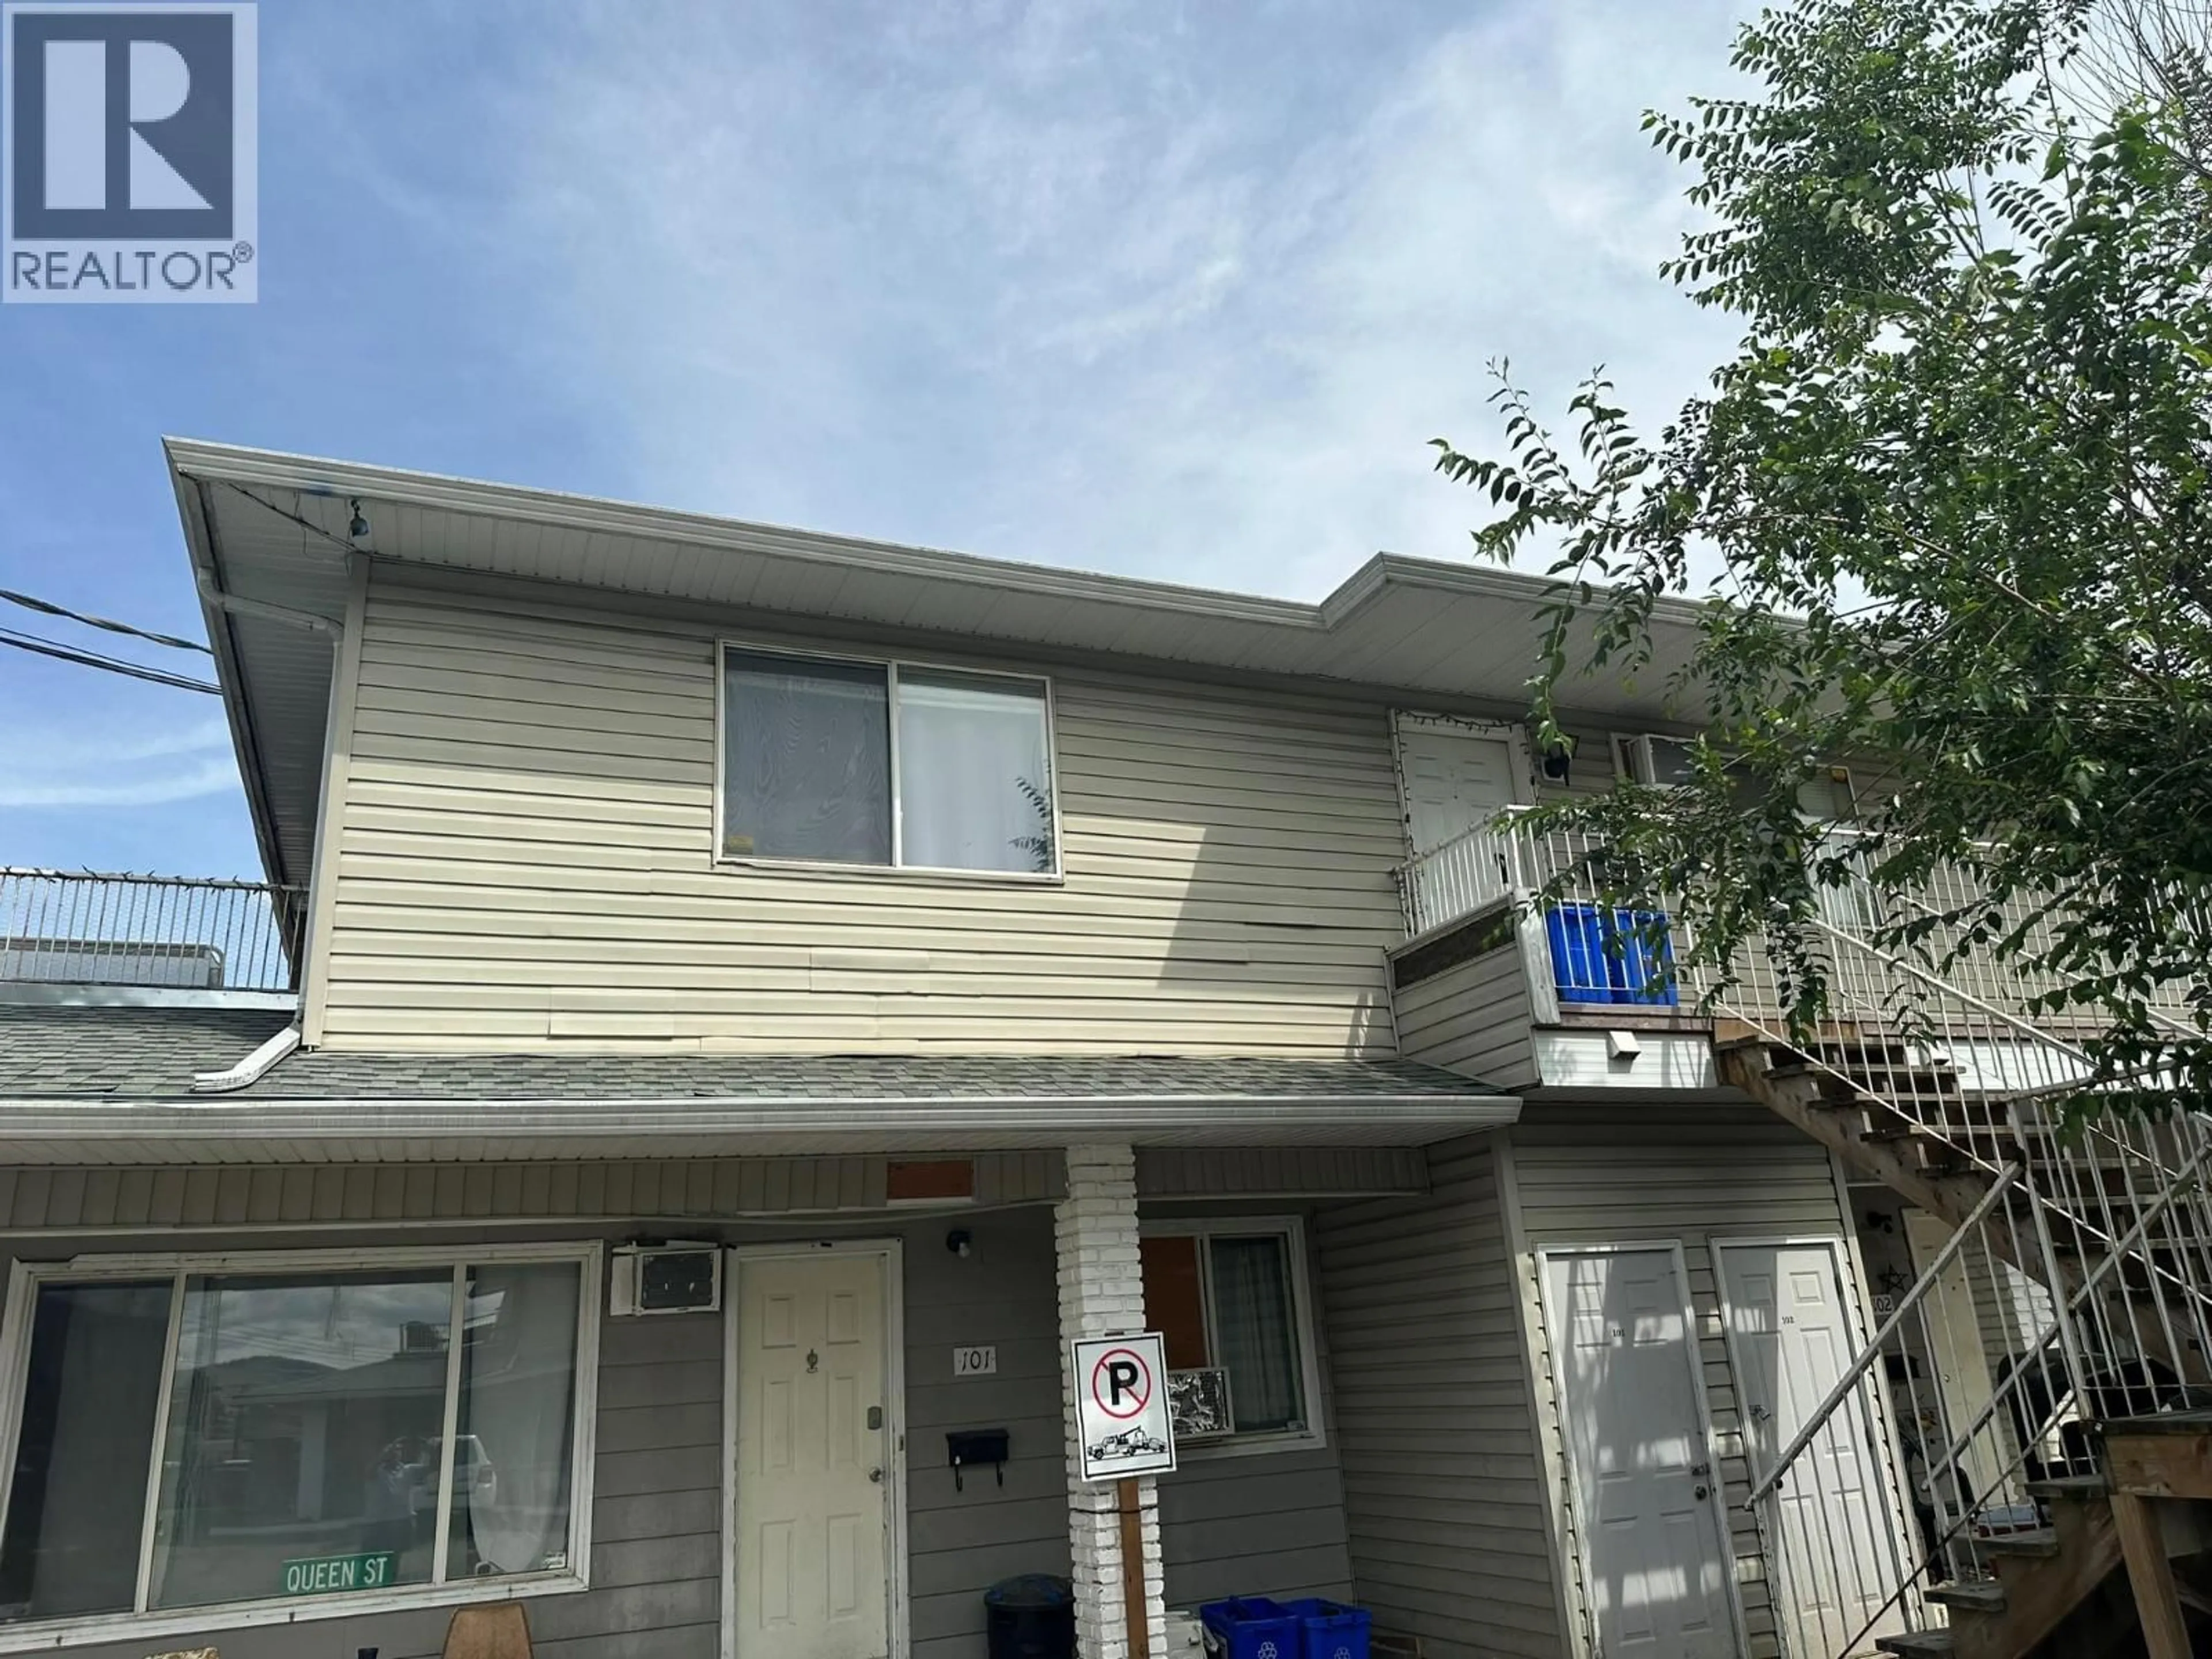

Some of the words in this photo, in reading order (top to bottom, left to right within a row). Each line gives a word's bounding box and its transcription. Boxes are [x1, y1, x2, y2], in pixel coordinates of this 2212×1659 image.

[1873, 1297, 1892, 1312] 02
[961, 1350, 990, 1372] 101
[1109, 1361, 1138, 1406] P
[287, 1559, 355, 1592] QUEEN
[363, 1557, 388, 1584] ST
